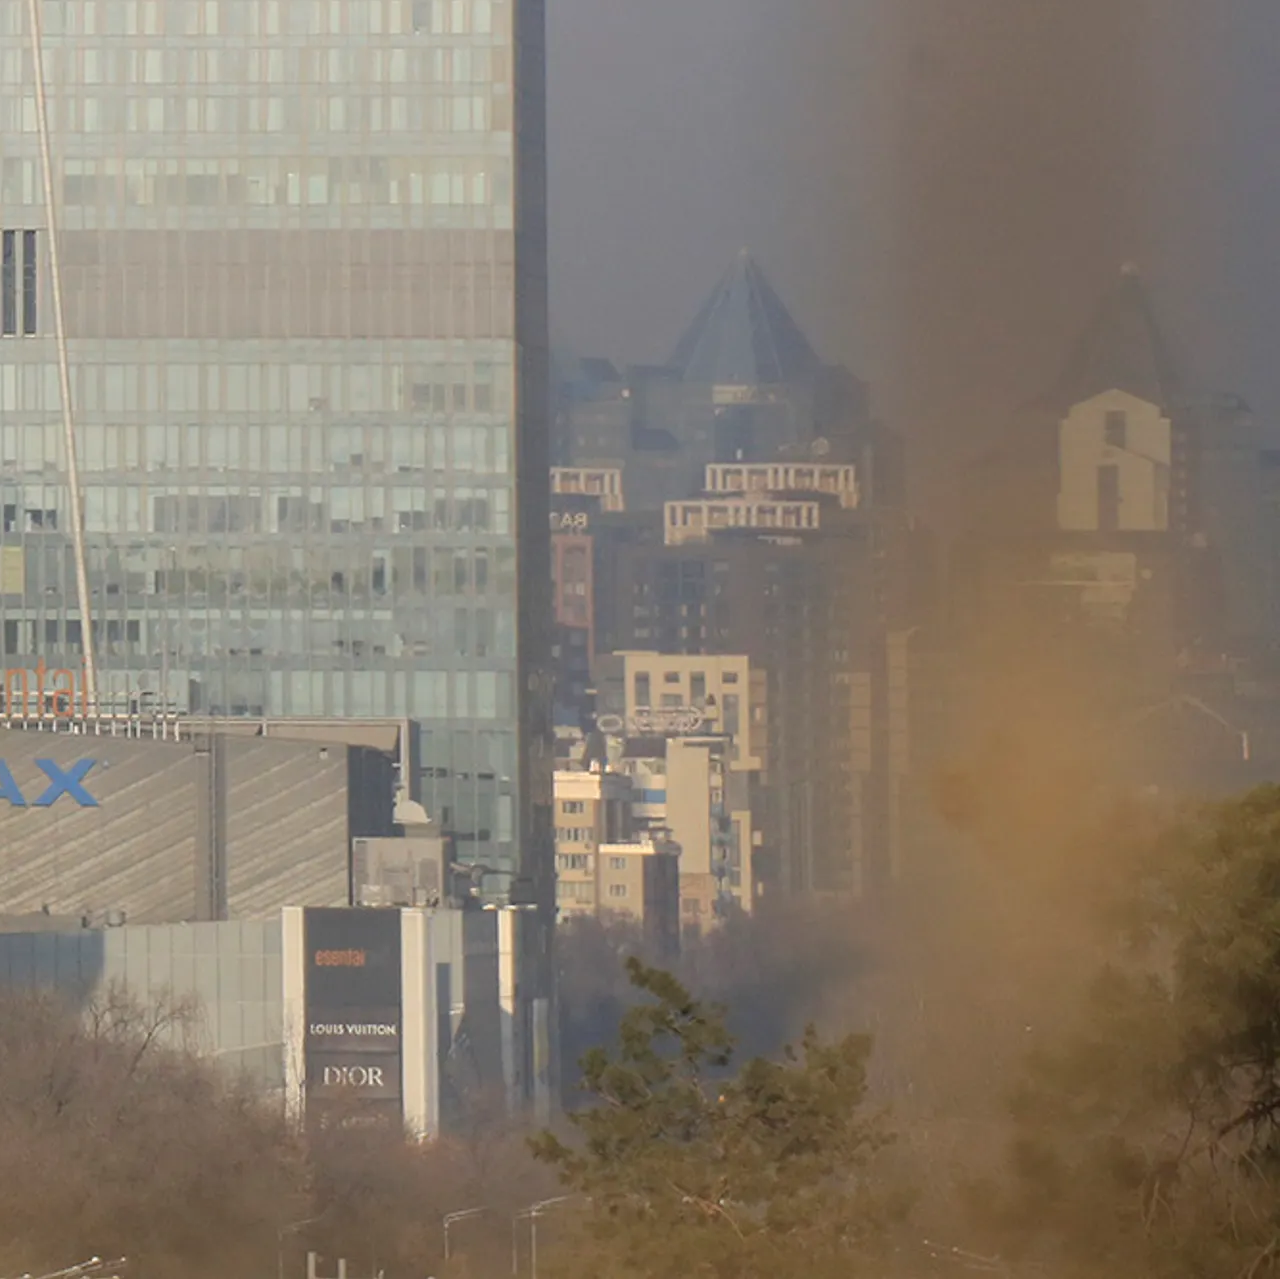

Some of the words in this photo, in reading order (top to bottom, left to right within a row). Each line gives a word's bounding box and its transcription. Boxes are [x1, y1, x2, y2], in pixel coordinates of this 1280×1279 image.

[310, 1023, 344, 1036] LOUIS
[346, 1023, 396, 1036] VUITTON
[324, 1066, 384, 1087] DIOR
